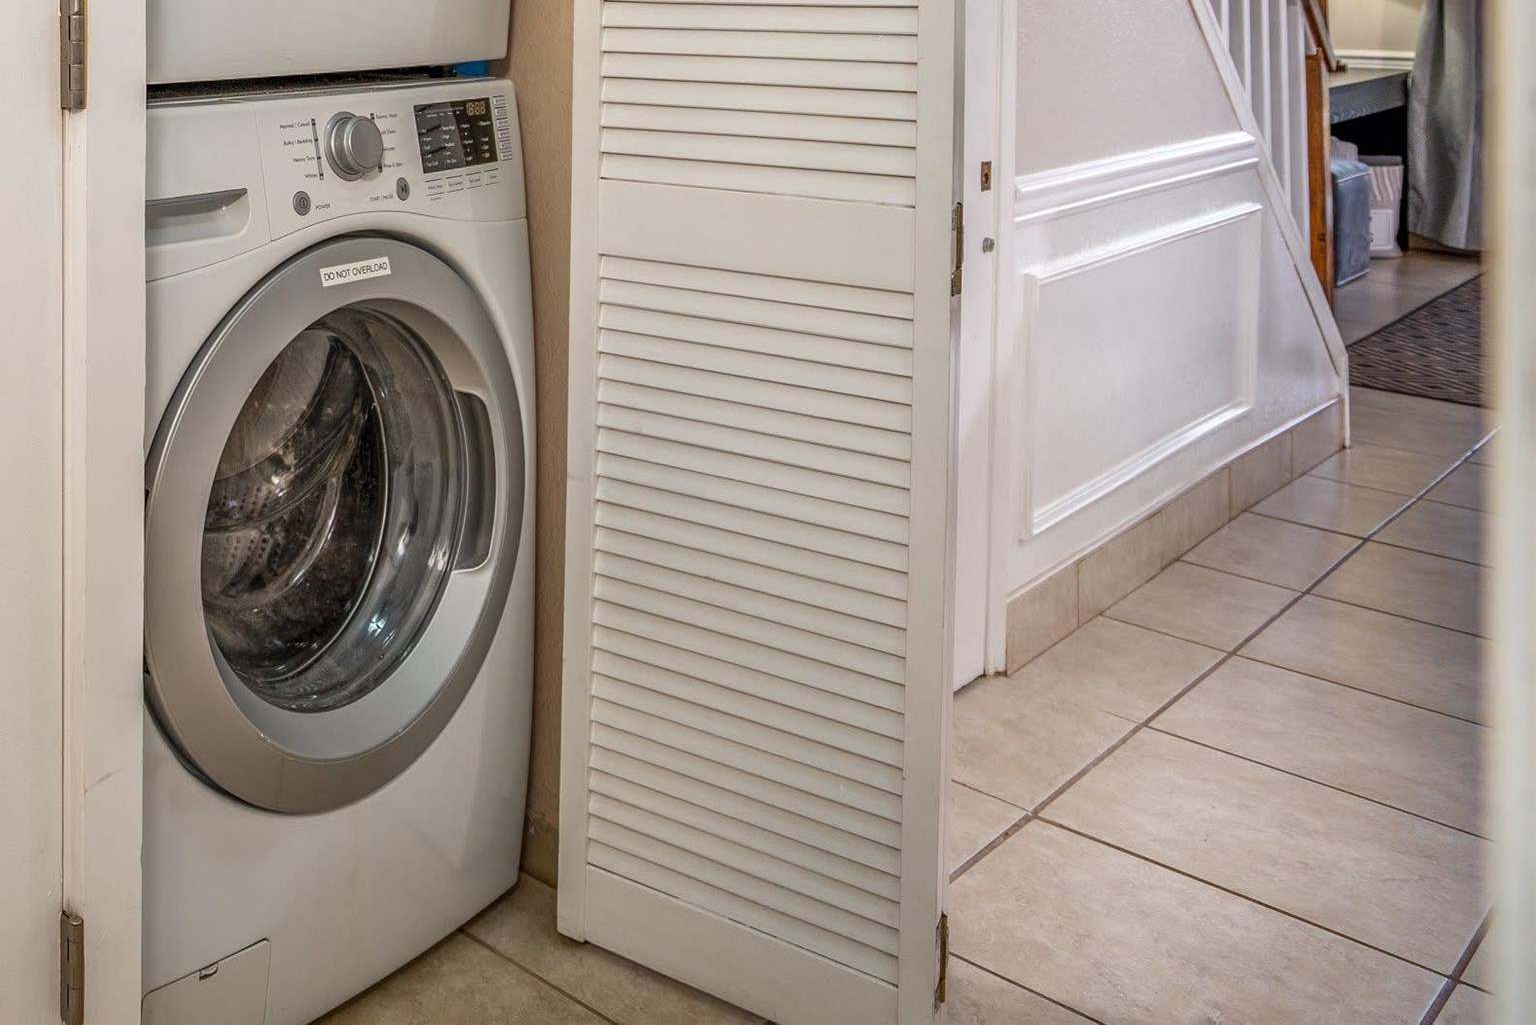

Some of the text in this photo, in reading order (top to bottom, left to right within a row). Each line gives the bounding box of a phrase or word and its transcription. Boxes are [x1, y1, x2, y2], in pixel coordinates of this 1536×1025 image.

[324, 262, 388, 281] DO NOT OVERLOAD
